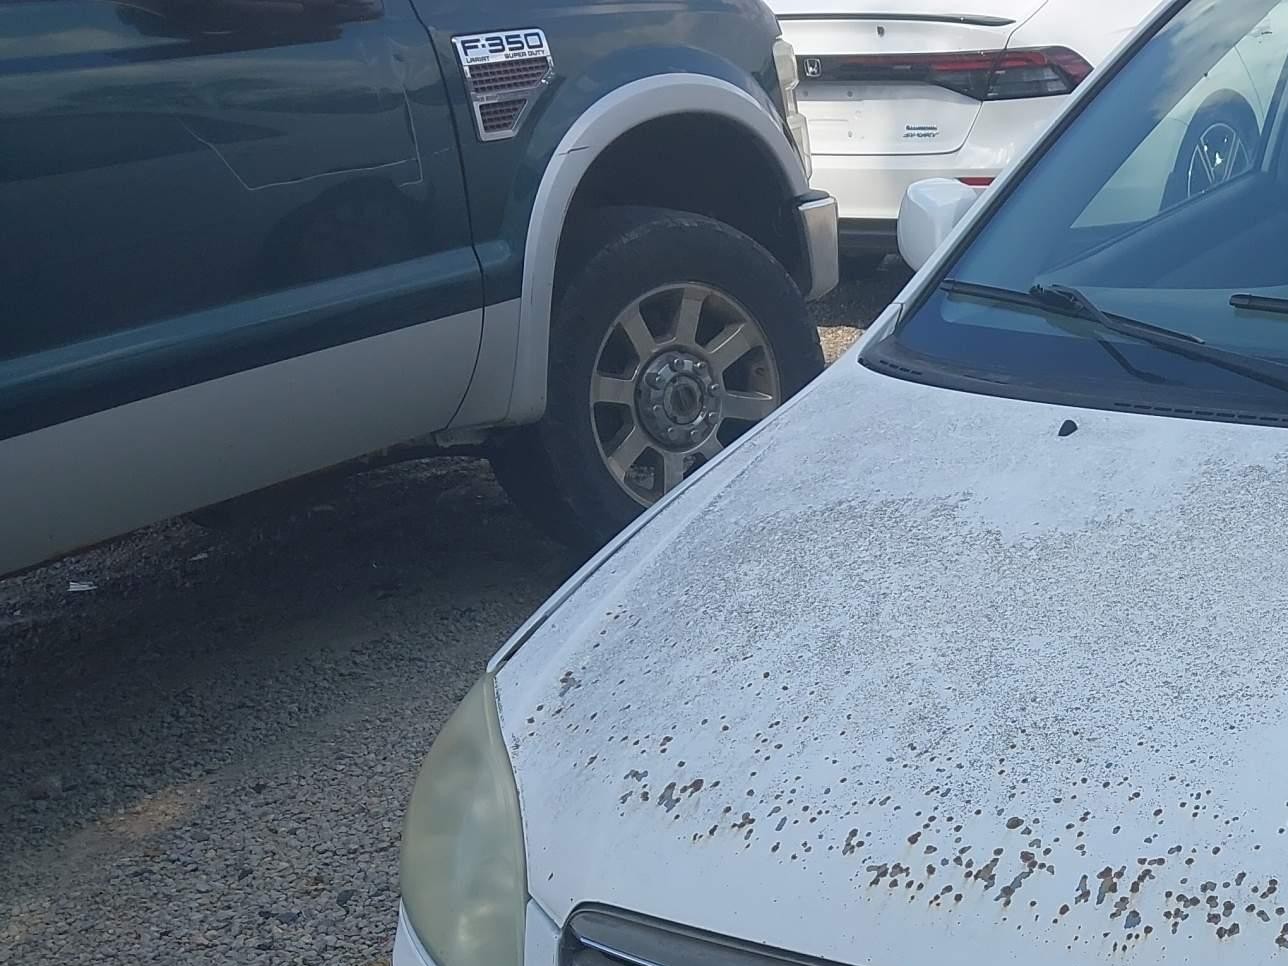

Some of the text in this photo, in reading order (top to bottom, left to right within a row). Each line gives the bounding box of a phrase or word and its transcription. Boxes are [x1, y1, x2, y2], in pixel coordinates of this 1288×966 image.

[460, 32, 544, 56] F-350
[466, 49, 545, 64] LARIAT SUPER DUTY
